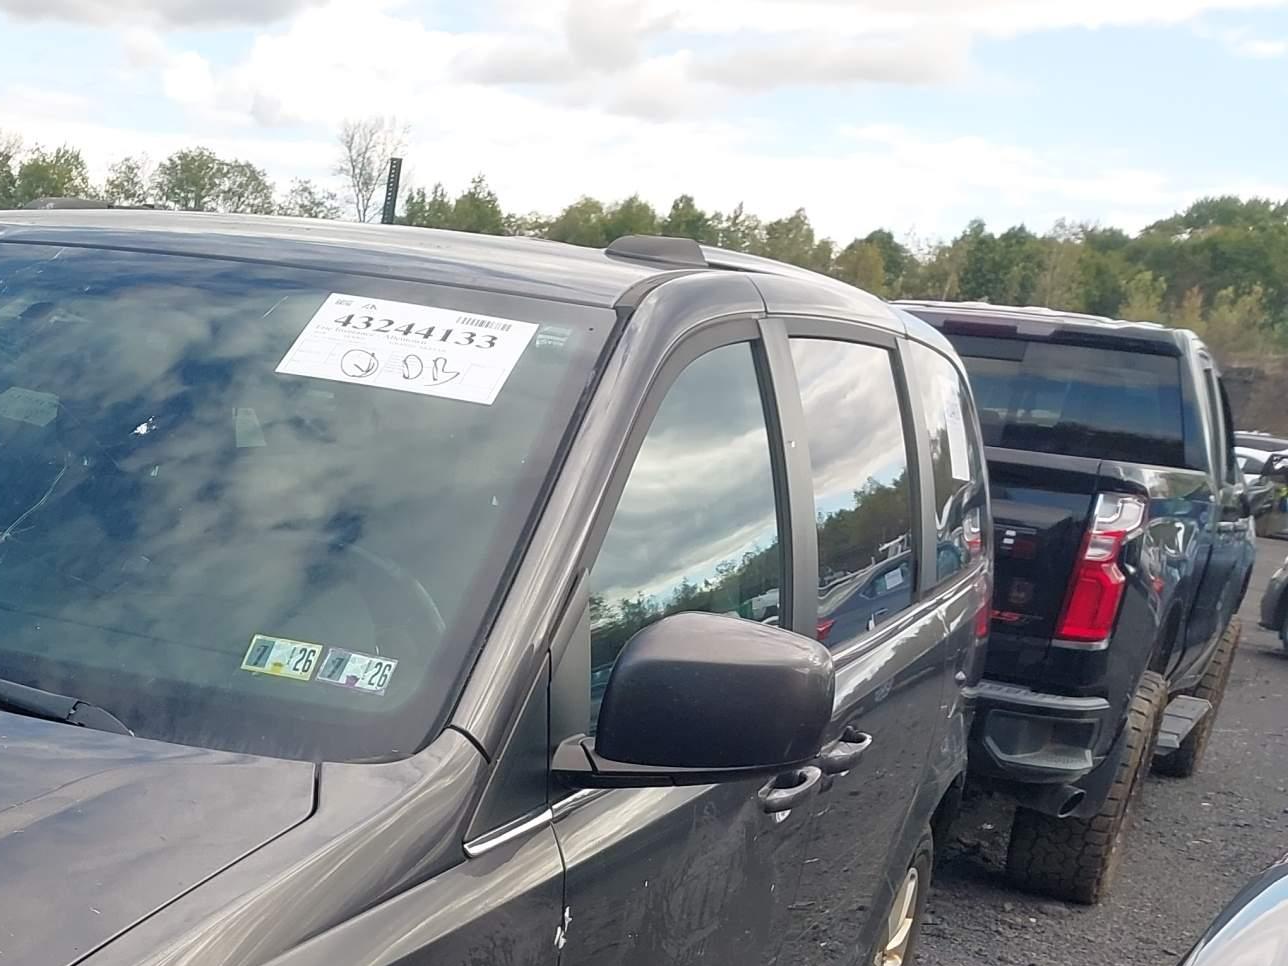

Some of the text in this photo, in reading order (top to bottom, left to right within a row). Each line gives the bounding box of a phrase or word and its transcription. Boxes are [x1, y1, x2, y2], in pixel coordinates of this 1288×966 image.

[333, 313, 499, 350] 43244133
[253, 645, 316, 673] 7 26
[327, 657, 392, 688] 7 26
